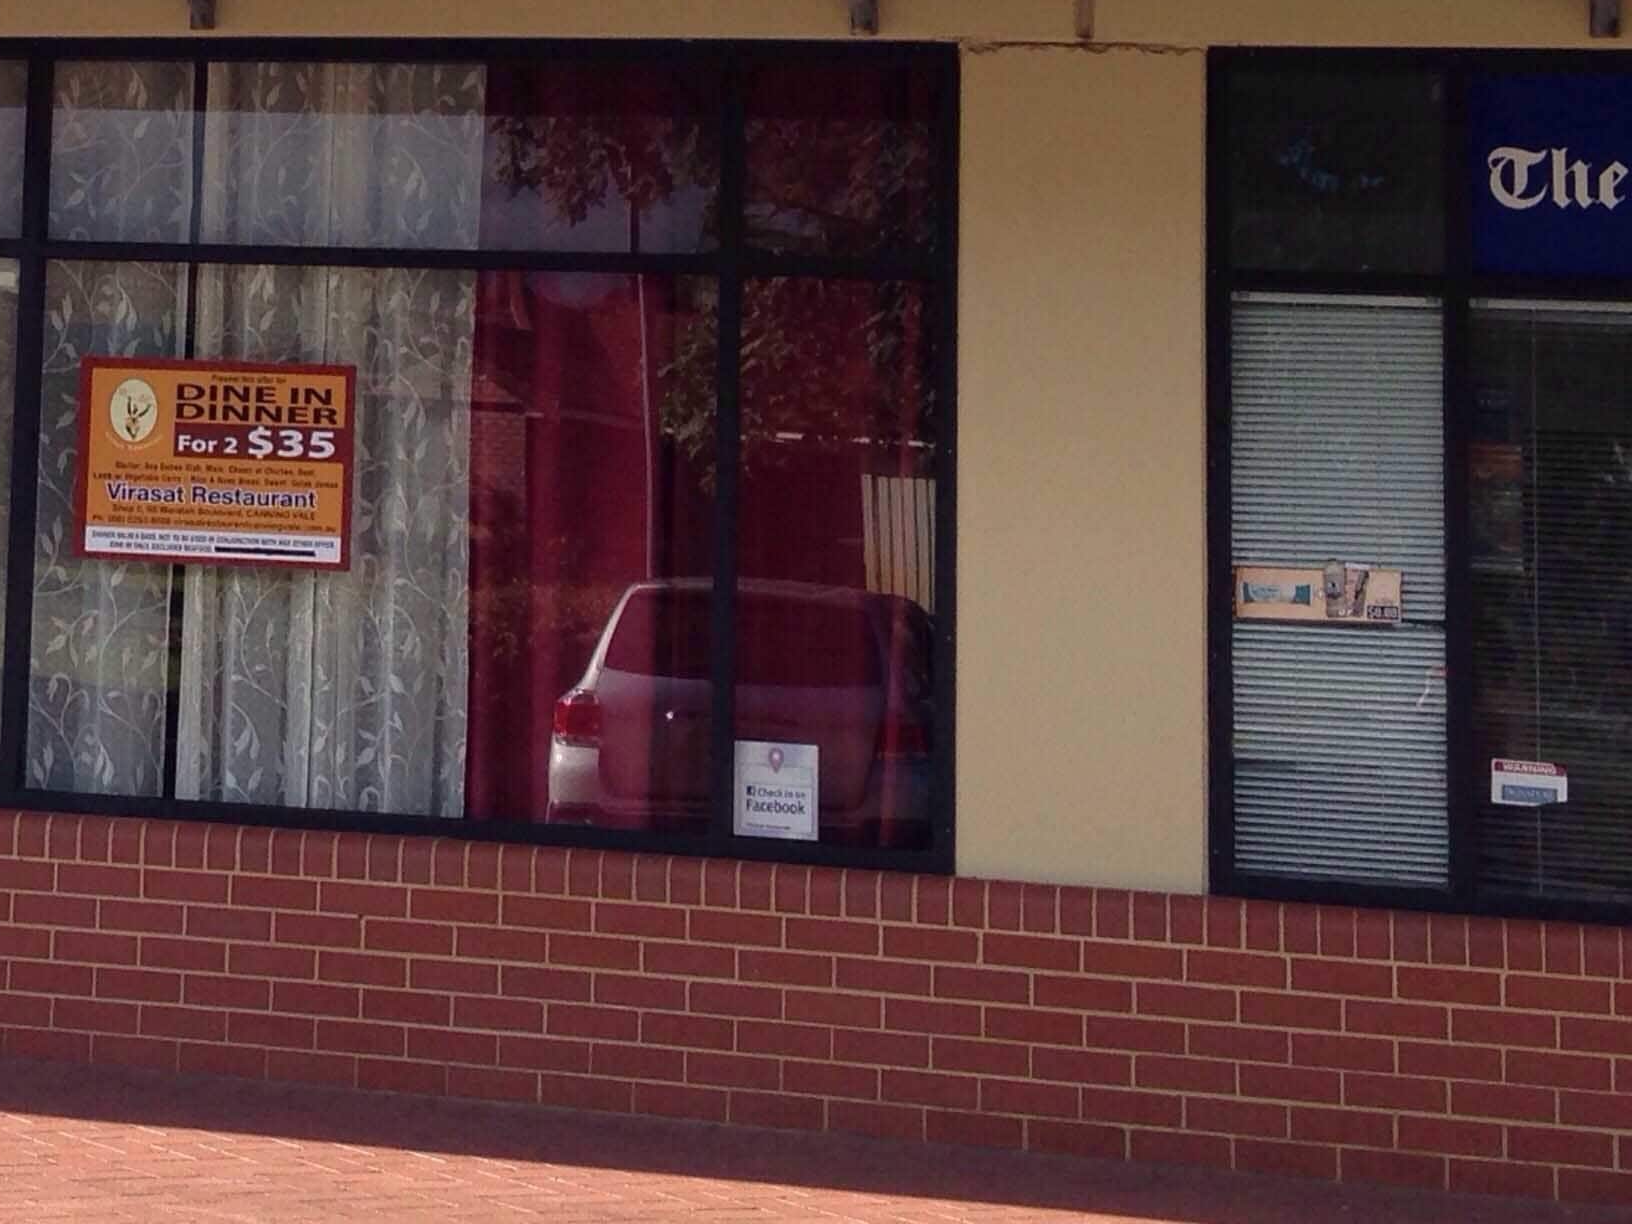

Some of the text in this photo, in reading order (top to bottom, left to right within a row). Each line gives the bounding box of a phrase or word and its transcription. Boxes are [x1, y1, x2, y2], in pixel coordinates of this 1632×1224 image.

[1486, 145, 1630, 211] The
[176, 383, 333, 406] DINE IN
[175, 403, 338, 425] DINNER
[177, 434, 218, 453] For
[223, 436, 238, 454] 2
[248, 426, 336, 460] $35
[106, 481, 317, 509] Virasat Restaurant
[746, 798, 806, 815] Facebook
